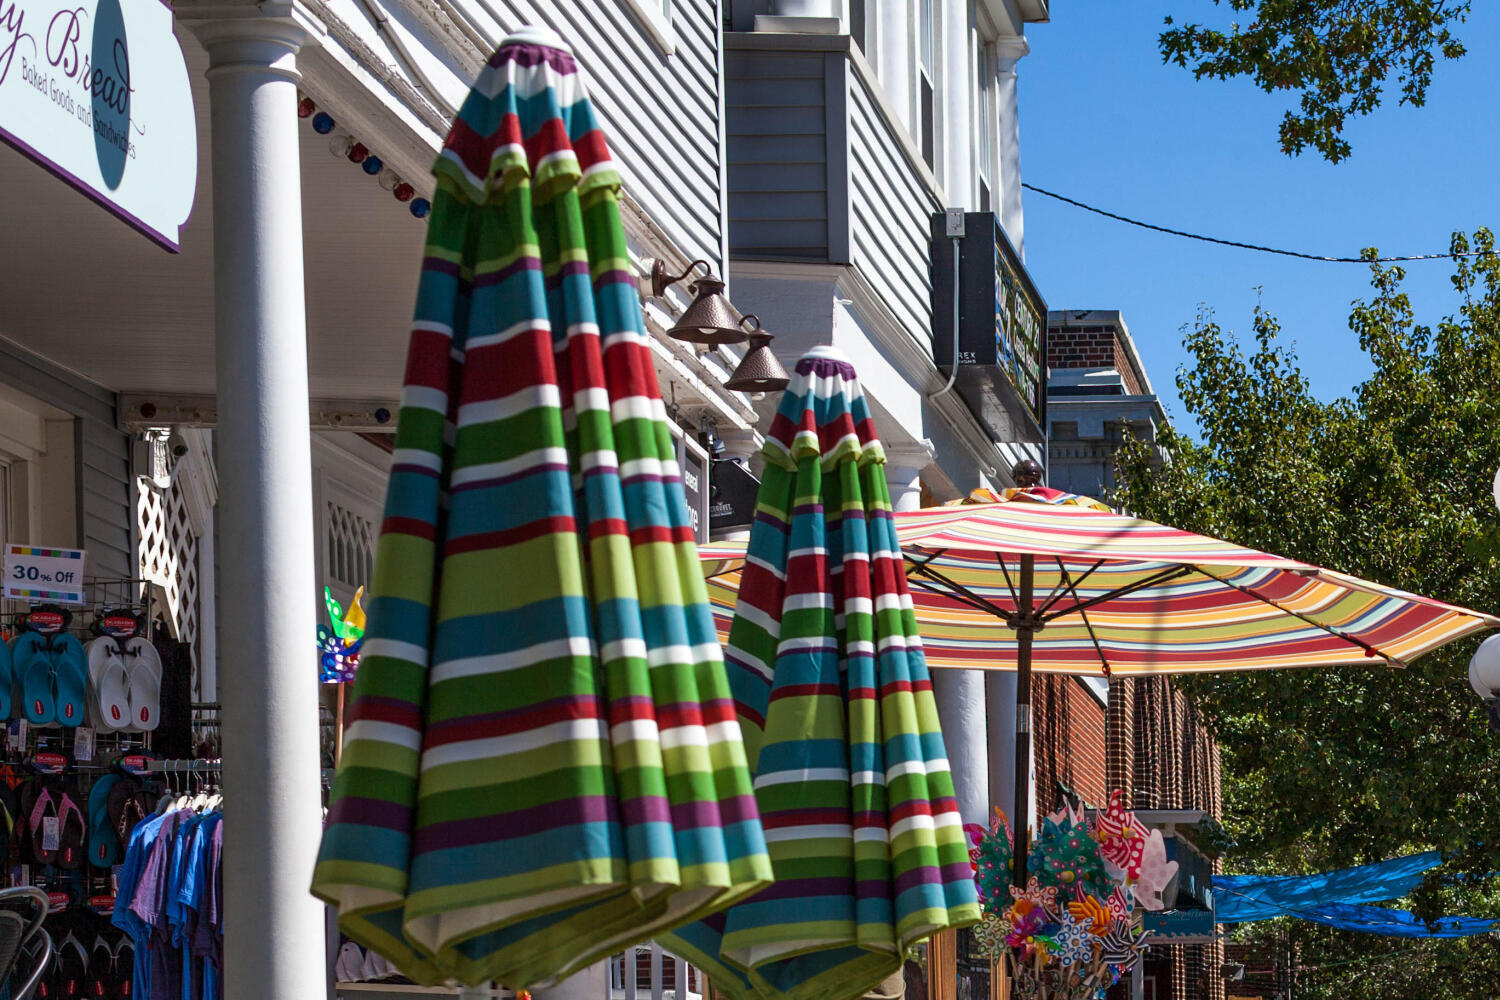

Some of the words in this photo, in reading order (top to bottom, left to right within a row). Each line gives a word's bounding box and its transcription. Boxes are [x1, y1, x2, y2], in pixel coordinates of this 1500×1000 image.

[46, 7, 145, 136] Bread
[22, 56, 48, 97] Baked
[50, 77, 75, 116] Goods
[77, 103, 92, 128] and
[93, 110, 137, 161] Sandwiches
[684, 470, 699, 493] eneral
[12, 564, 53, 582] 30%
[55, 570, 75, 584] Off
